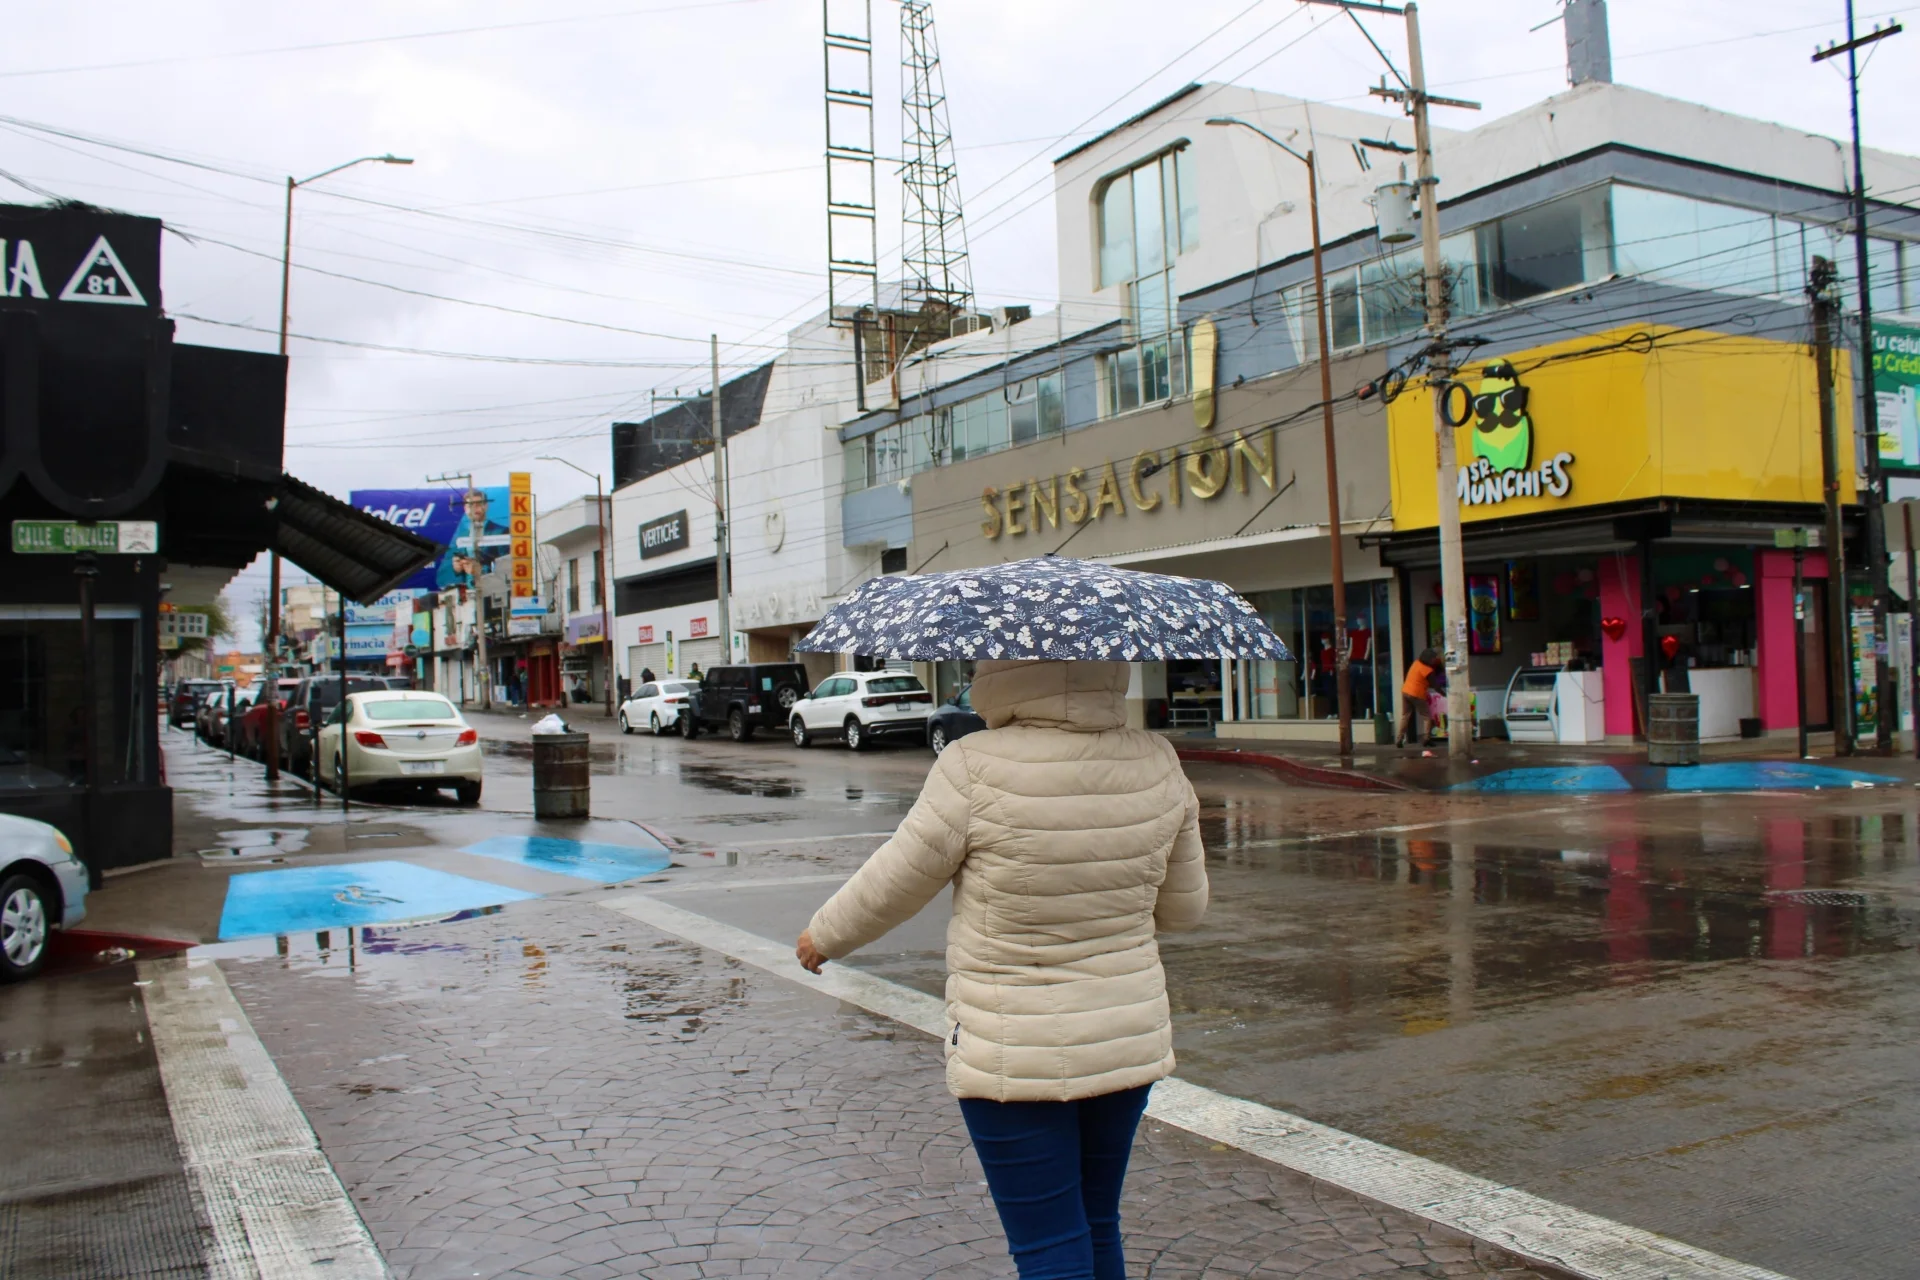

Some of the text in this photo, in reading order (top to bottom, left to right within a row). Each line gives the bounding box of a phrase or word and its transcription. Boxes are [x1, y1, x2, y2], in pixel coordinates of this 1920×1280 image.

[87, 275, 117, 295] 81
[1470, 458, 1495, 482] SR.
[17, 527, 53, 547] CALLE
[63, 526, 116, 547] GONZALEZ
[642, 519, 682, 549] VERTICHE
[513, 495, 528, 597] Kodak
[332, 638, 385, 649] Frmacia
